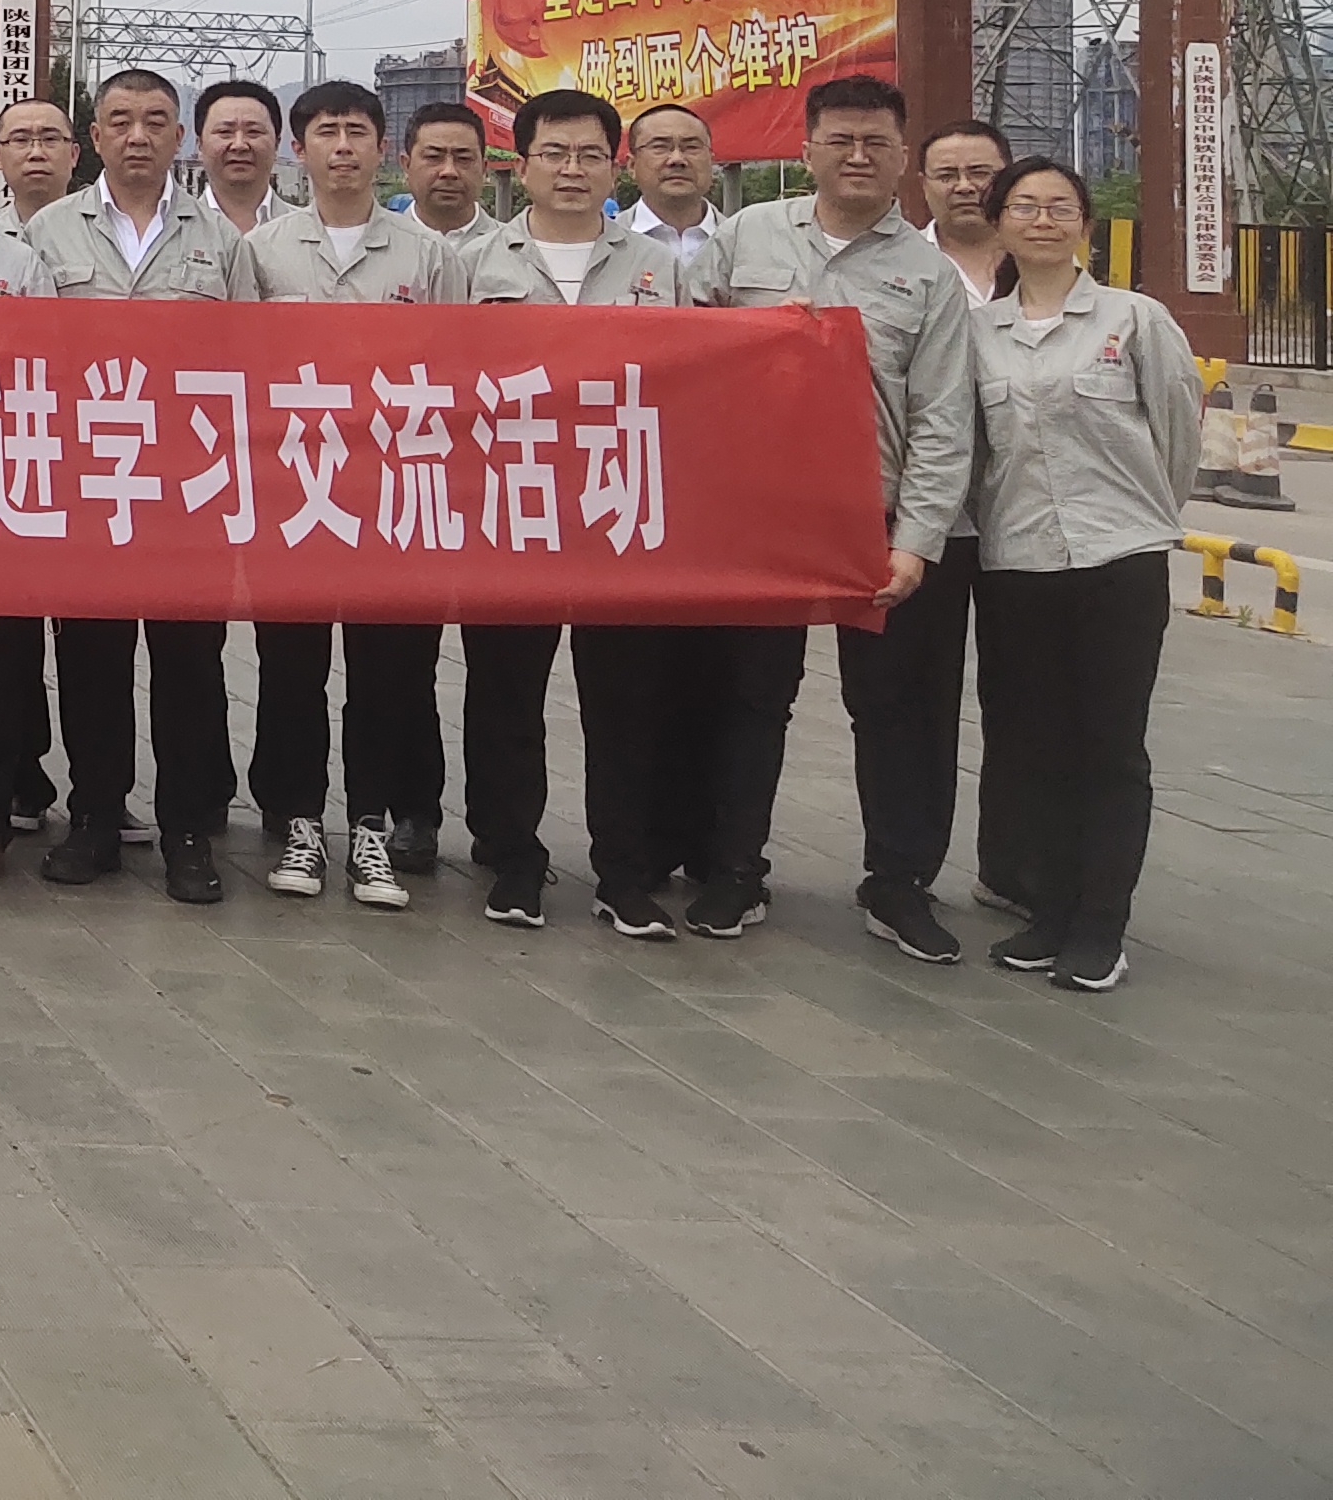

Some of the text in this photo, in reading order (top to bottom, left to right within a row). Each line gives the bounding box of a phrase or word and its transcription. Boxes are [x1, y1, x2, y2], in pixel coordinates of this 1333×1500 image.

[0, 8, 31, 113] 陕钢集团汉中
[578, 13, 819, 102] 做到两个维护
[1193, 54, 1217, 283] 中共陕钢集团汉中钢铁有限责任公司纪律检查委员会
